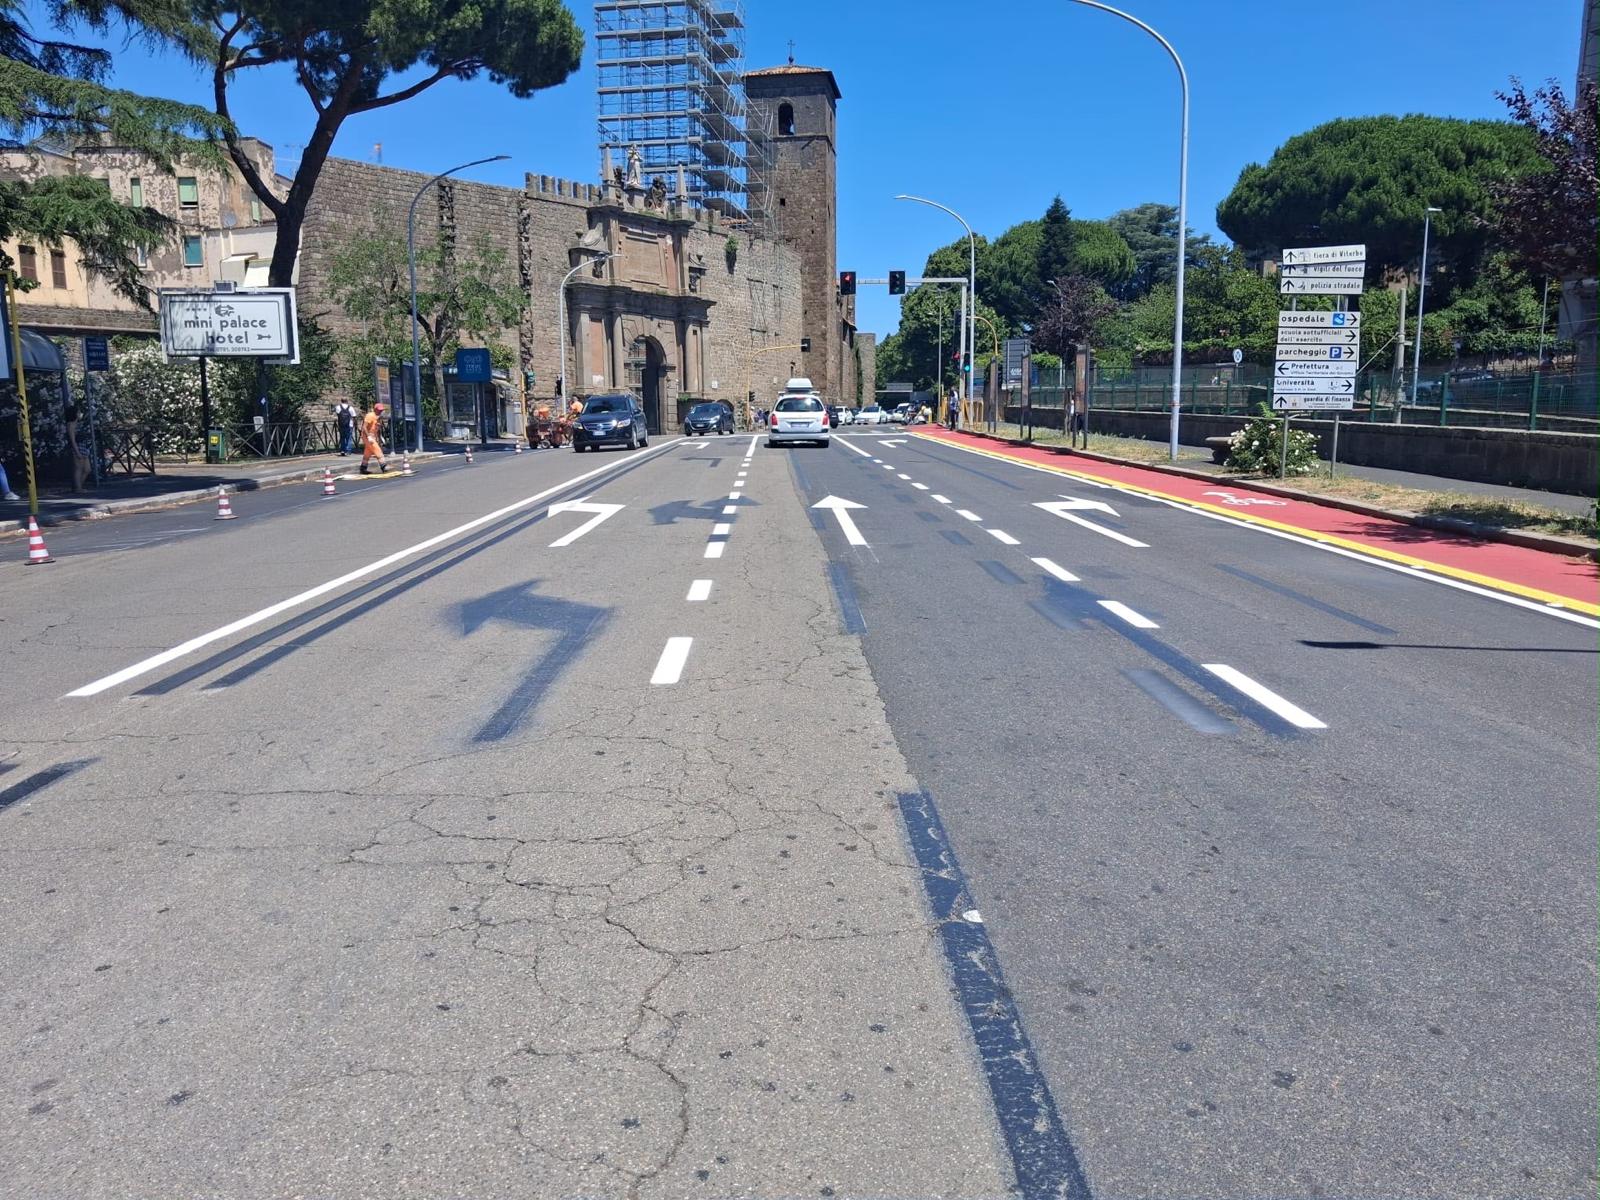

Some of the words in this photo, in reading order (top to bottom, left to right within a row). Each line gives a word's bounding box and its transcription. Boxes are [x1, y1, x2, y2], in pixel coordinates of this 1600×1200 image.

[1339, 249, 1363, 257] Viterbo
[1310, 281, 1332, 290] polizia
[1334, 281, 1360, 289] stradale
[1281, 315, 1325, 323] ospedale
[184, 315, 212, 328] mini
[220, 315, 267, 332] palace
[205, 331, 248, 344] hotel
[1278, 348, 1327, 357] parcheggio
[1291, 362, 1330, 370] Prefettura
[1303, 395, 1324, 403] guardia
